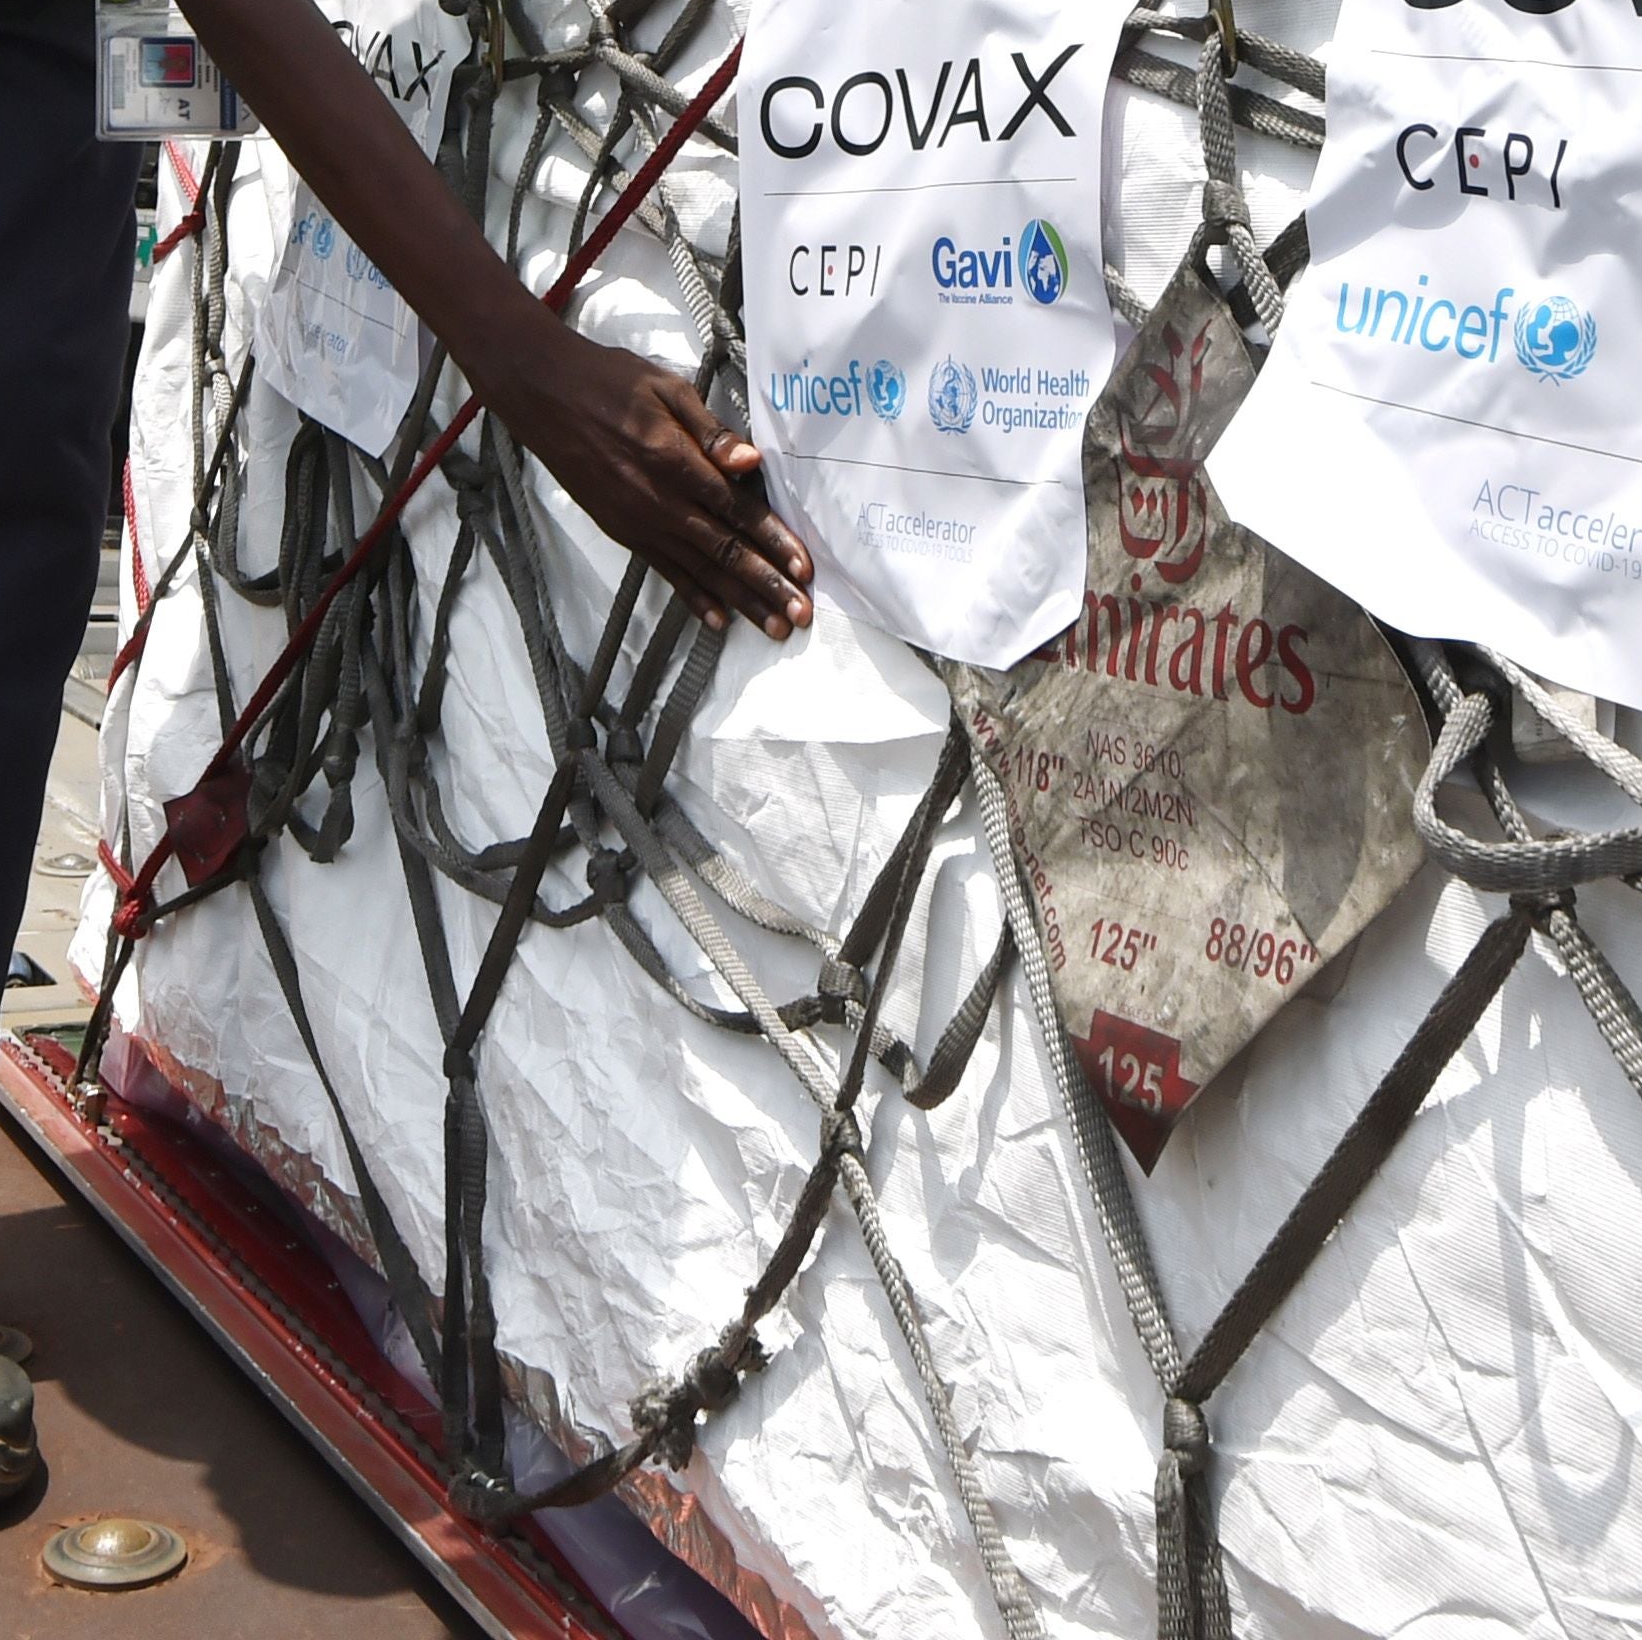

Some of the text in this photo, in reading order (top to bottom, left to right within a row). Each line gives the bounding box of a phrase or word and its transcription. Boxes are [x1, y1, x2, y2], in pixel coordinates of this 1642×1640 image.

[177, 97, 190, 121] AT
[760, 43, 1085, 159] COVAX
[1395, 123, 1568, 208] CEPI
[789, 245, 882, 297] CEPI
[931, 236, 1013, 289] Gavi
[938, 292, 1014, 305] The Vaccine Alliance
[1336, 274, 1515, 364] unicef
[771, 358, 862, 417] unicef
[981, 367, 1090, 398] World Health
[982, 400, 1084, 434] Organization
[886, 535, 899, 552] TO
[944, 546, 974, 564] TOOLS
[1469, 518, 1530, 550] ACCESS
[1537, 534, 1559, 558] TO
[1563, 543, 1642, 581] COVID-19
[1029, 573, 1315, 715] mirates
[1086, 729, 1126, 765] NAS
[1073, 771, 1193, 827] 2A1N/2M2N
[1079, 816, 1189, 871] TSO C 90c
[1098, 1045, 1164, 1116] 125
